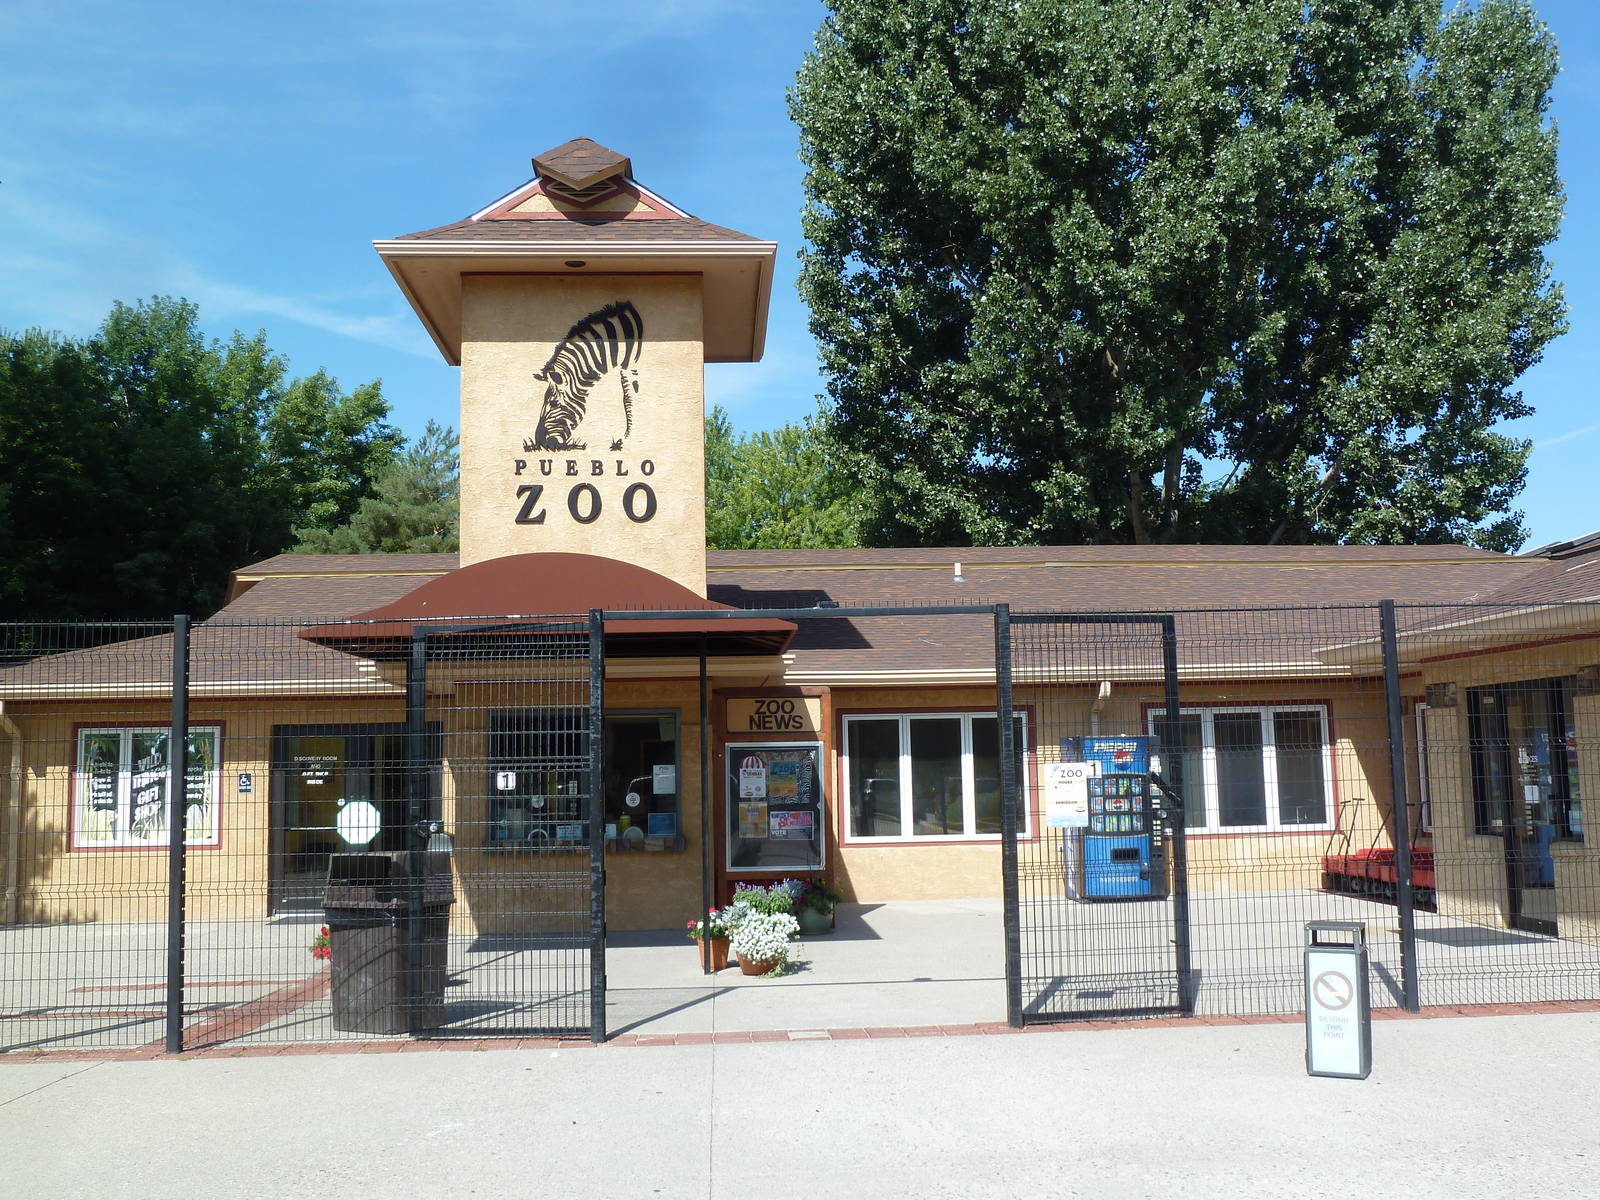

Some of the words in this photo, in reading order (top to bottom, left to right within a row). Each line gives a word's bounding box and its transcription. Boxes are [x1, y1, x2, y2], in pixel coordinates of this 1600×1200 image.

[514, 459, 655, 476] PUEBLO
[514, 482, 657, 525] ZOO
[755, 700, 795, 715] ZOO
[750, 715, 803, 730] NEWS
[502, 773, 510, 788] 1
[1060, 769, 1083, 778] ZOO
[137, 786, 160, 805] GIFT
[134, 800, 161, 821] SHOP
[1319, 1015, 1348, 1024] BEYOND
[1323, 1031, 1344, 1039] POINT
[1327, 1024, 1342, 1032] THIS
